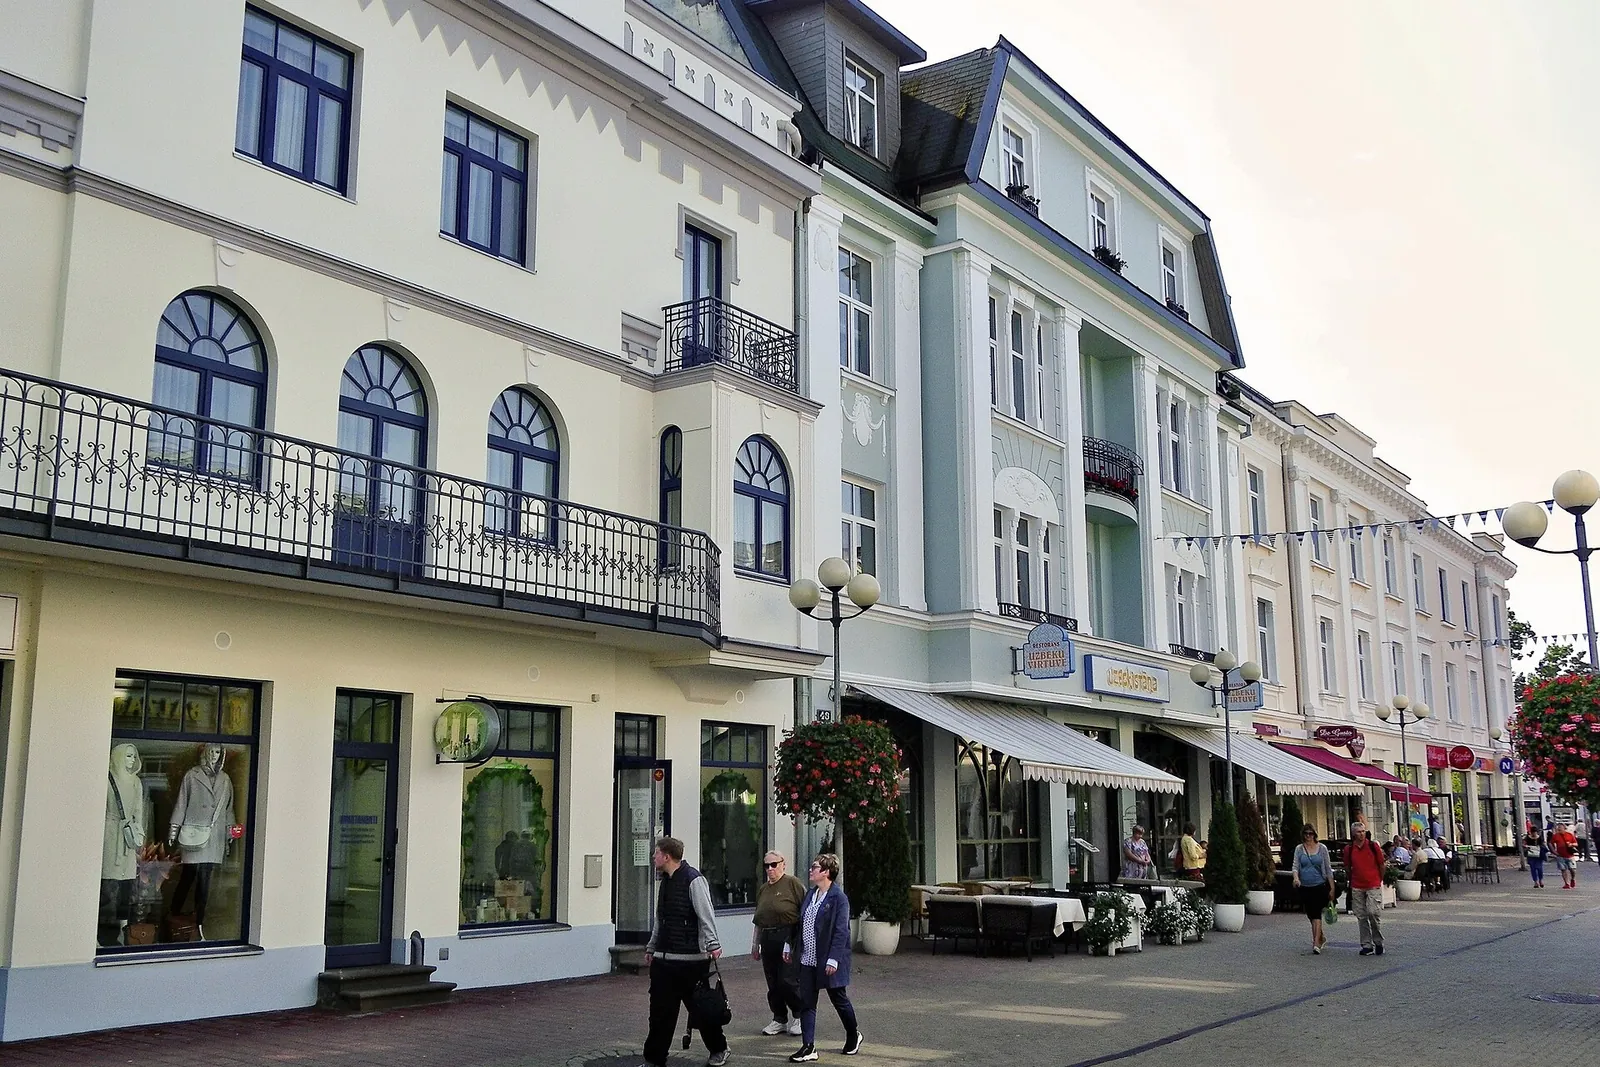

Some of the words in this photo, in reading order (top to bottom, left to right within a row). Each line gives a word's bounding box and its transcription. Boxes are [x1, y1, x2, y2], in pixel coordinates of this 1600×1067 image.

[1029, 651, 1065, 661] UZBEKU
[1027, 659, 1067, 669] VIRTUVE
[1502, 761, 1510, 770] N
